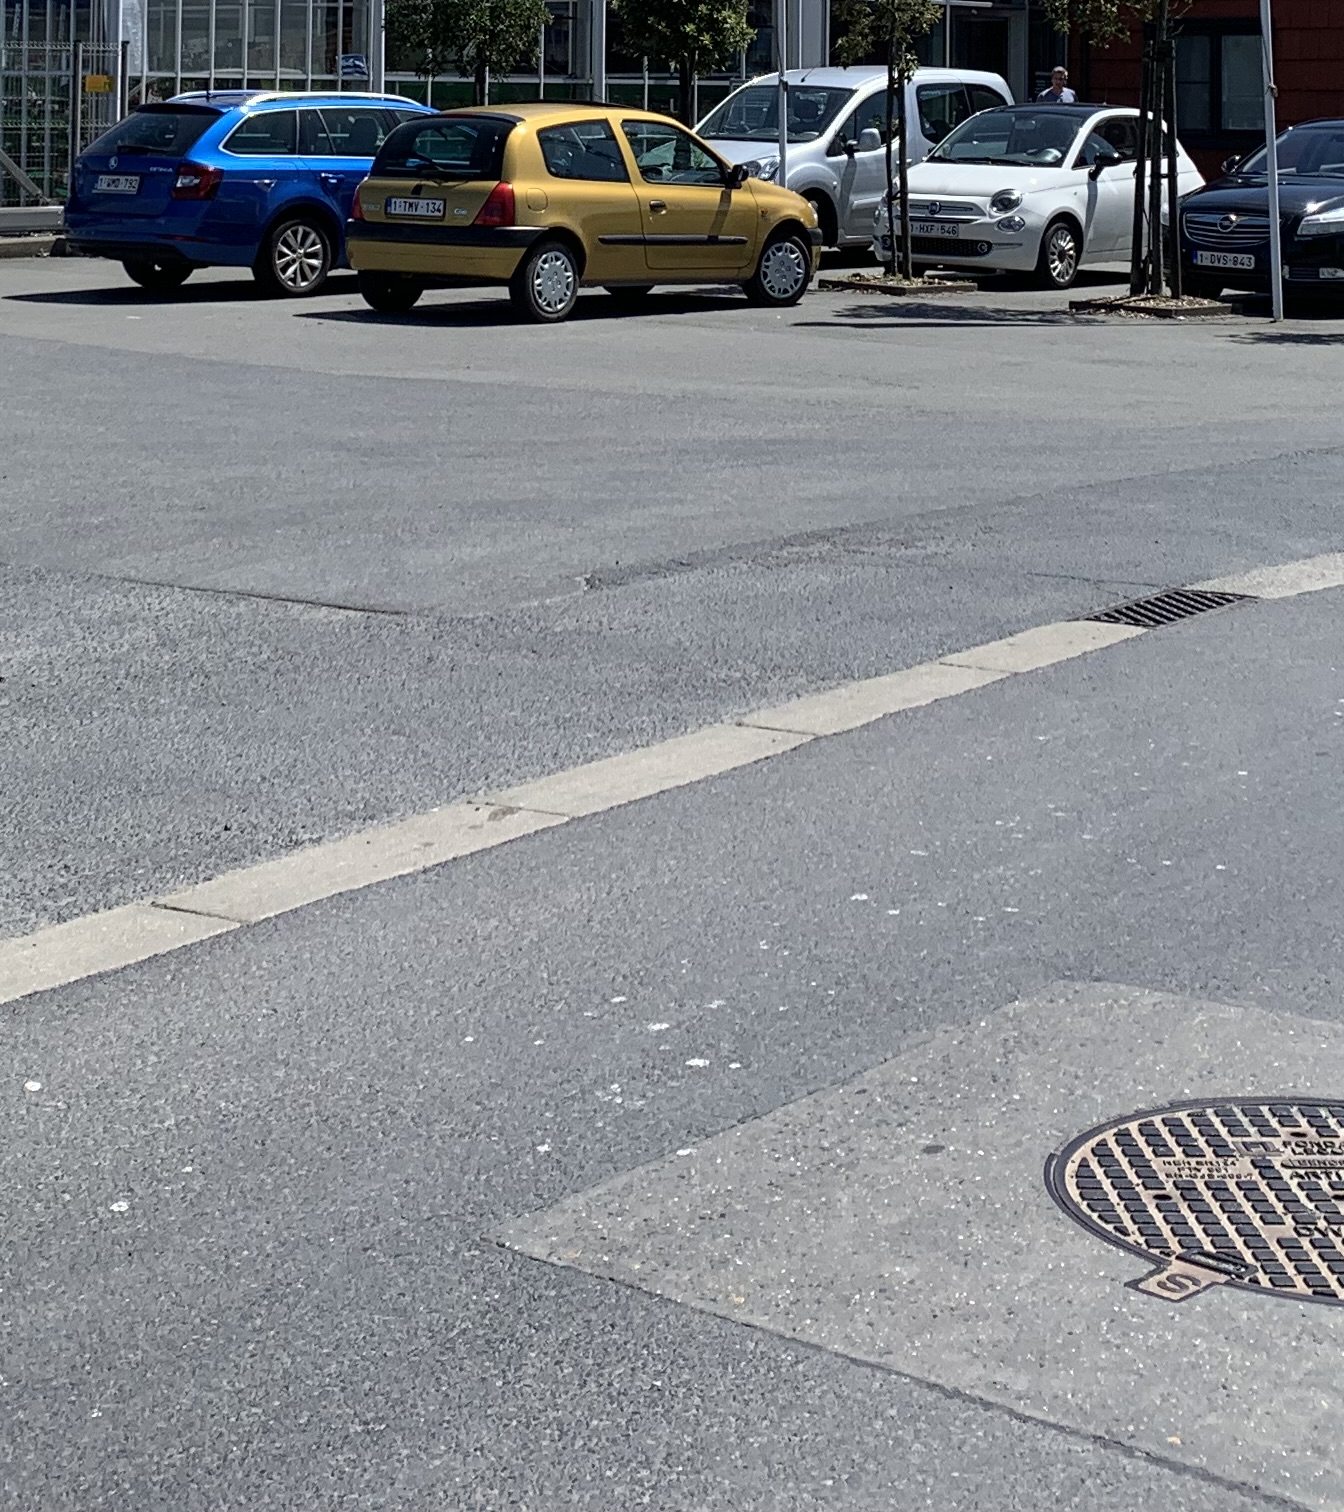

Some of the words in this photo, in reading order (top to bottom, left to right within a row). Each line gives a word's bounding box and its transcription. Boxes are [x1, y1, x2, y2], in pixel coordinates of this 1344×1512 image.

[393, 200, 442, 214] 1-TMV-134
[1199, 253, 1253, 267] 1-DVS-843
[1157, 1274, 1201, 1293] S
